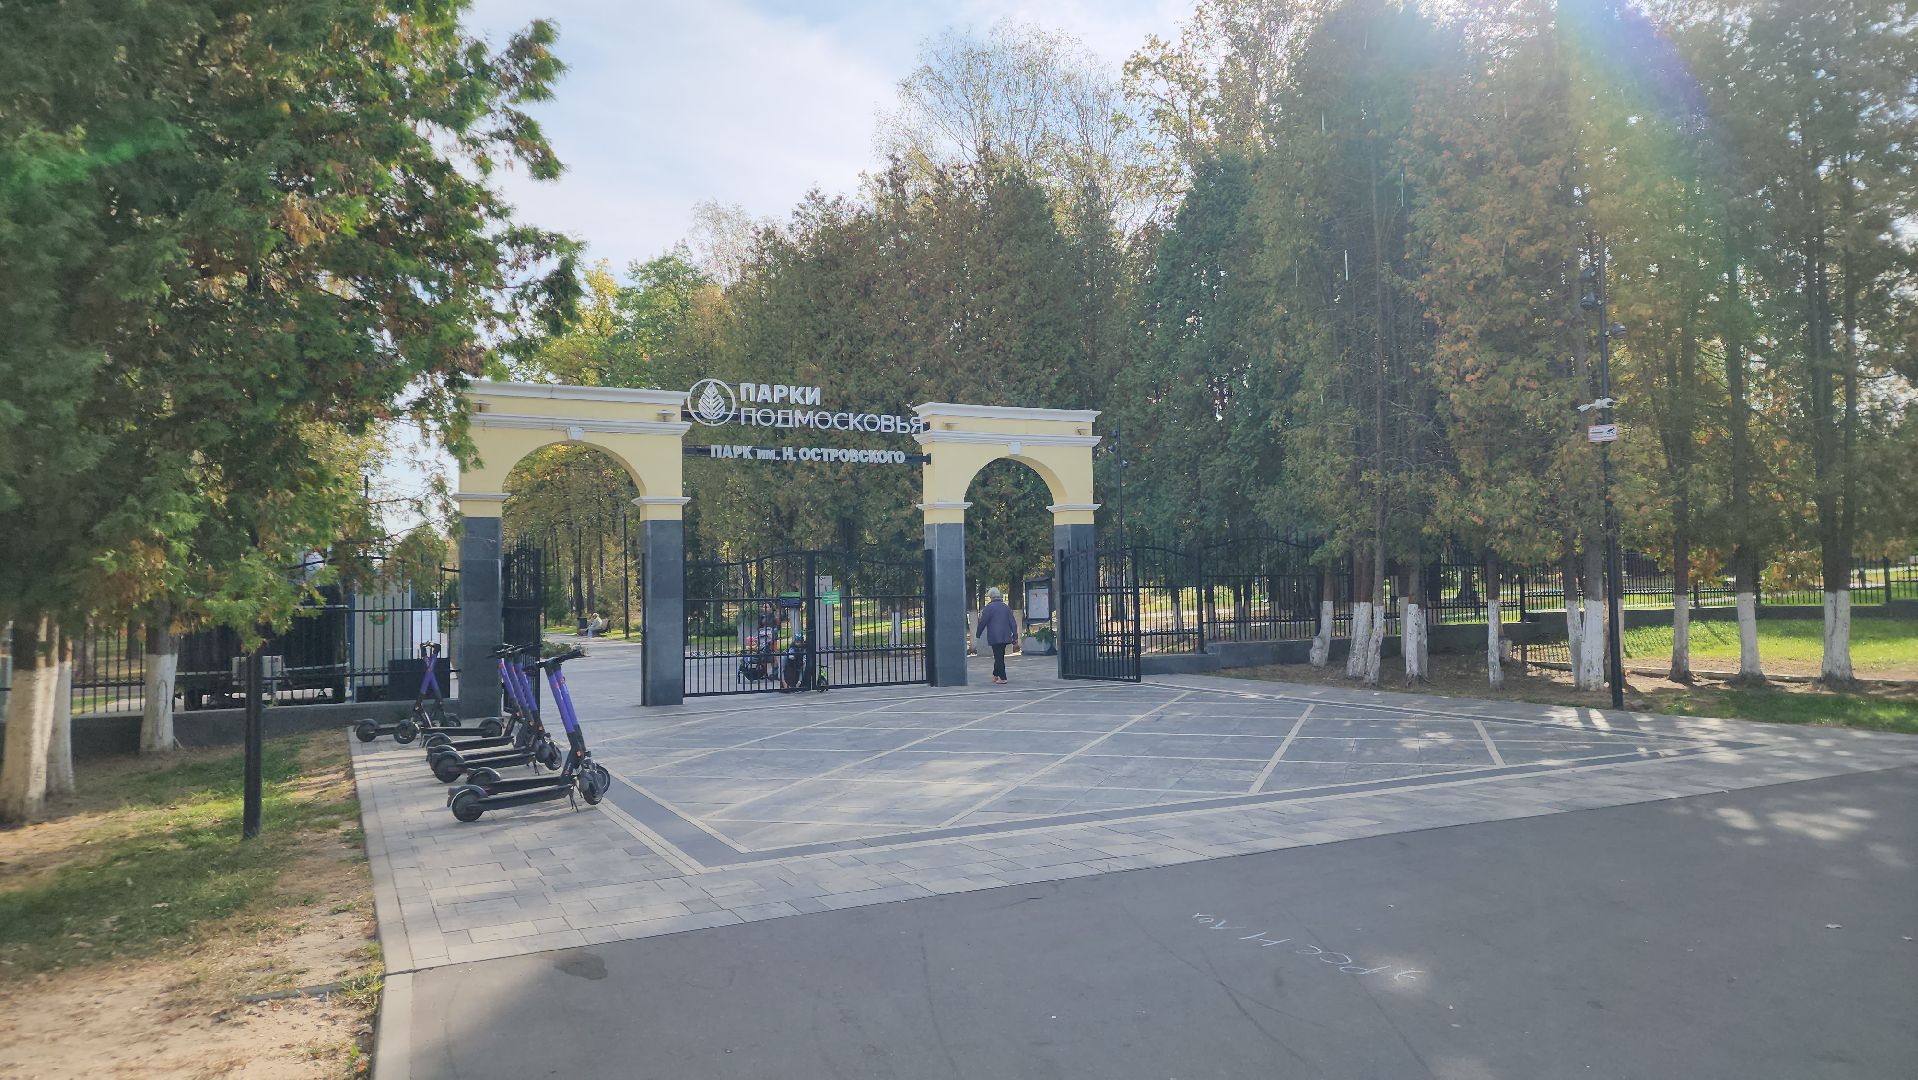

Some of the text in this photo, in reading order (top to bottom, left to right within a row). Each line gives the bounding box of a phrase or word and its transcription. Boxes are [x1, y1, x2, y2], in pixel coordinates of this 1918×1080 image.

[740, 382, 821, 406] ПАРКИ
[741, 407, 924, 434] ПОДМОСКОВЬЯ
[710, 444, 753, 459] ПАРК
[782, 446, 797, 461] Н.
[799, 447, 906, 464] ОСТРОВСКОГО
